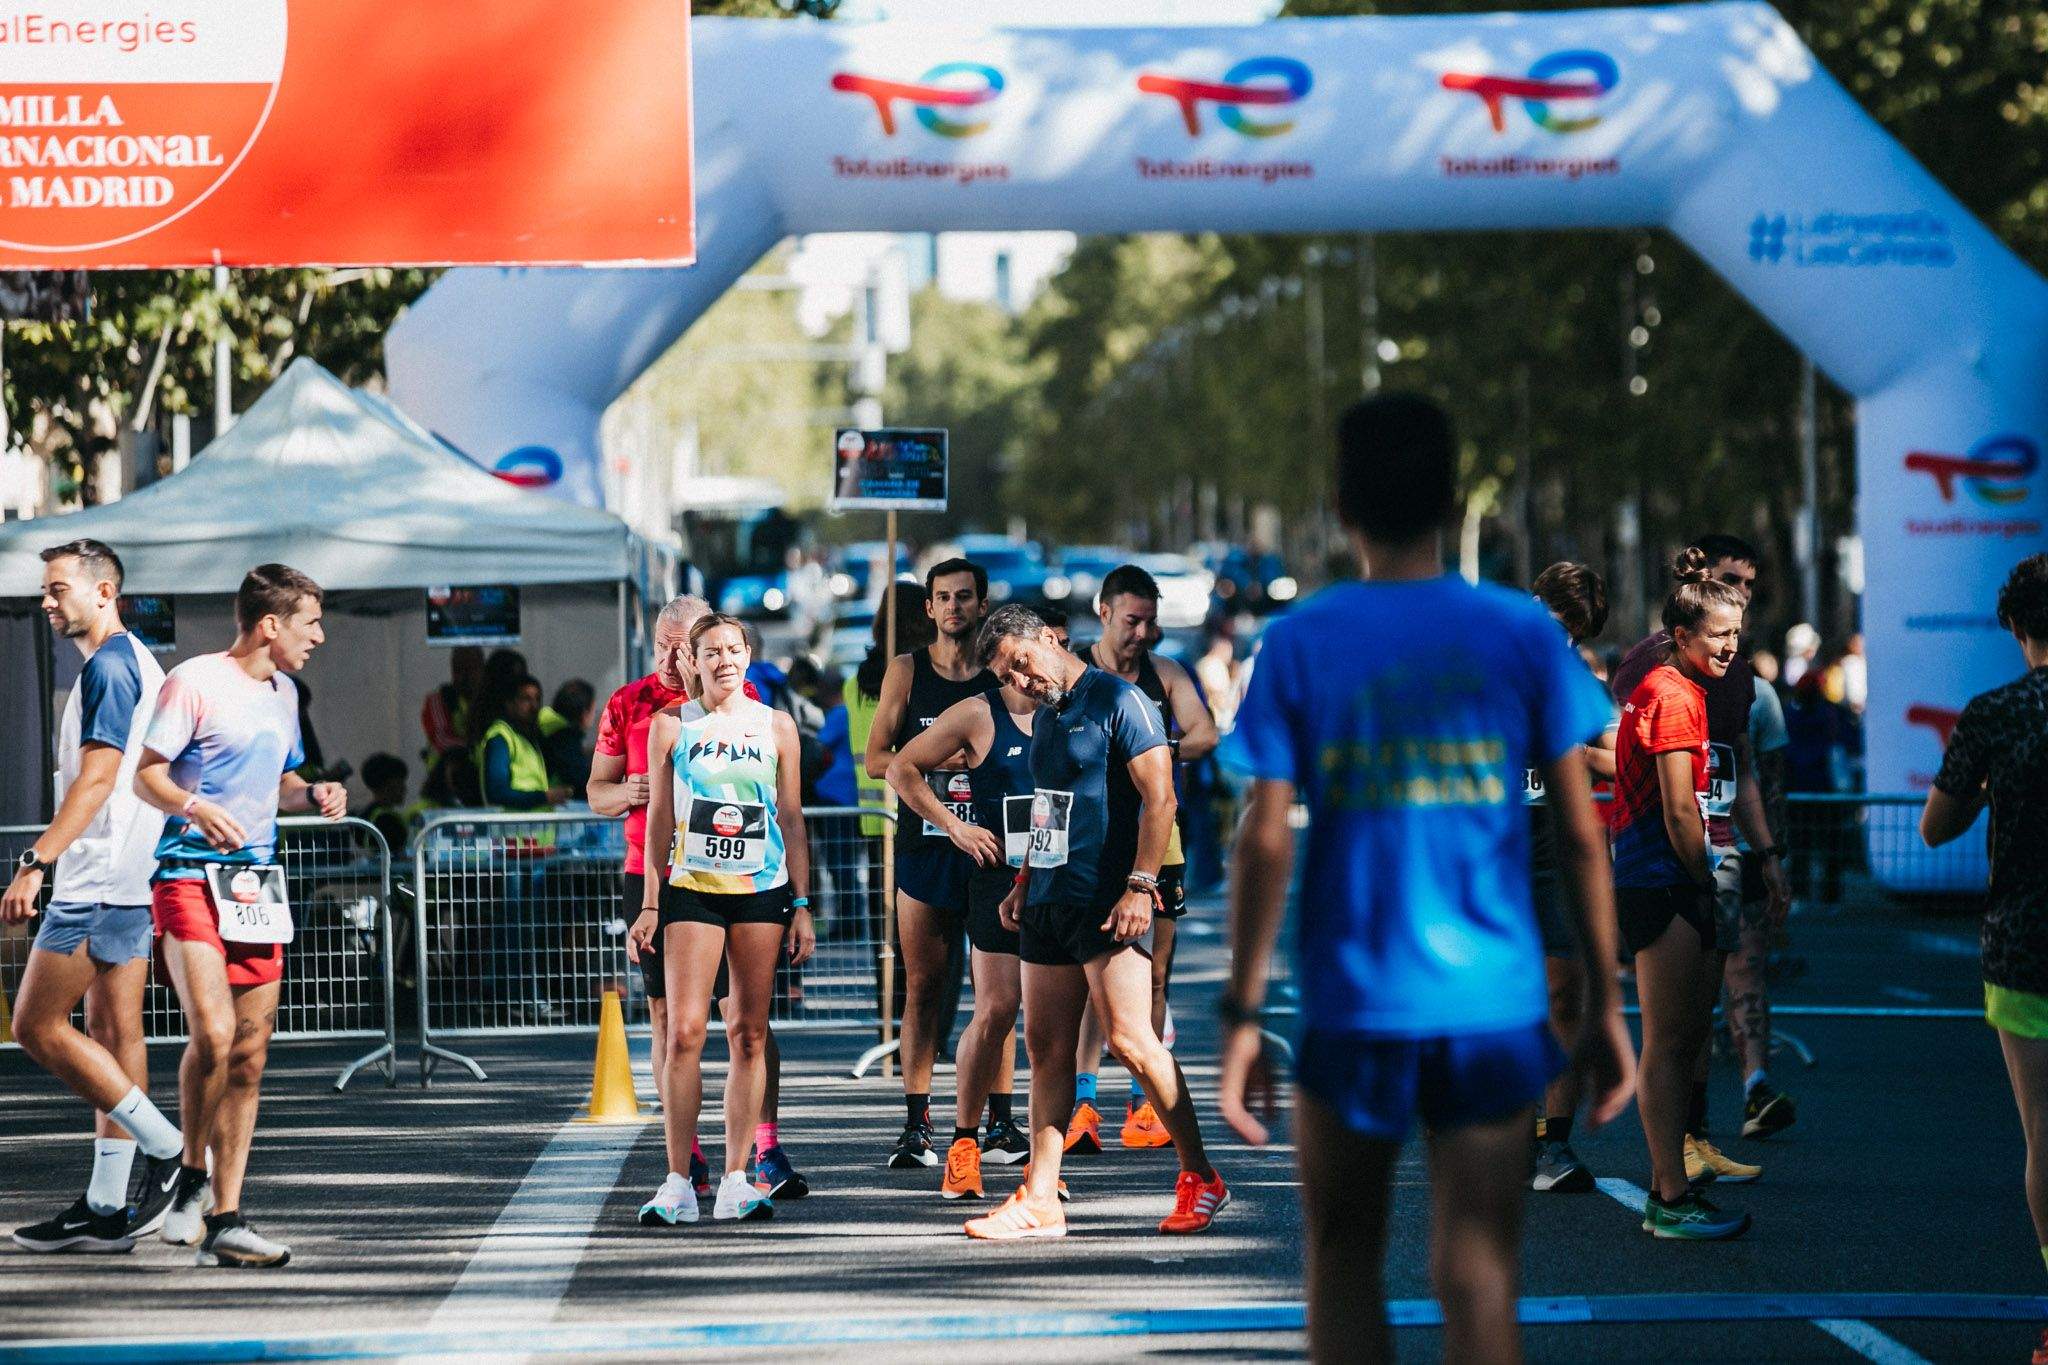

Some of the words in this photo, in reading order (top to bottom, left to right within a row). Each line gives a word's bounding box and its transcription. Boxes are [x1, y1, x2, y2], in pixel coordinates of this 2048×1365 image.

[9, 176, 174, 208] MADRID
[689, 741, 762, 763] BERLIN
[705, 836, 746, 860] 599
